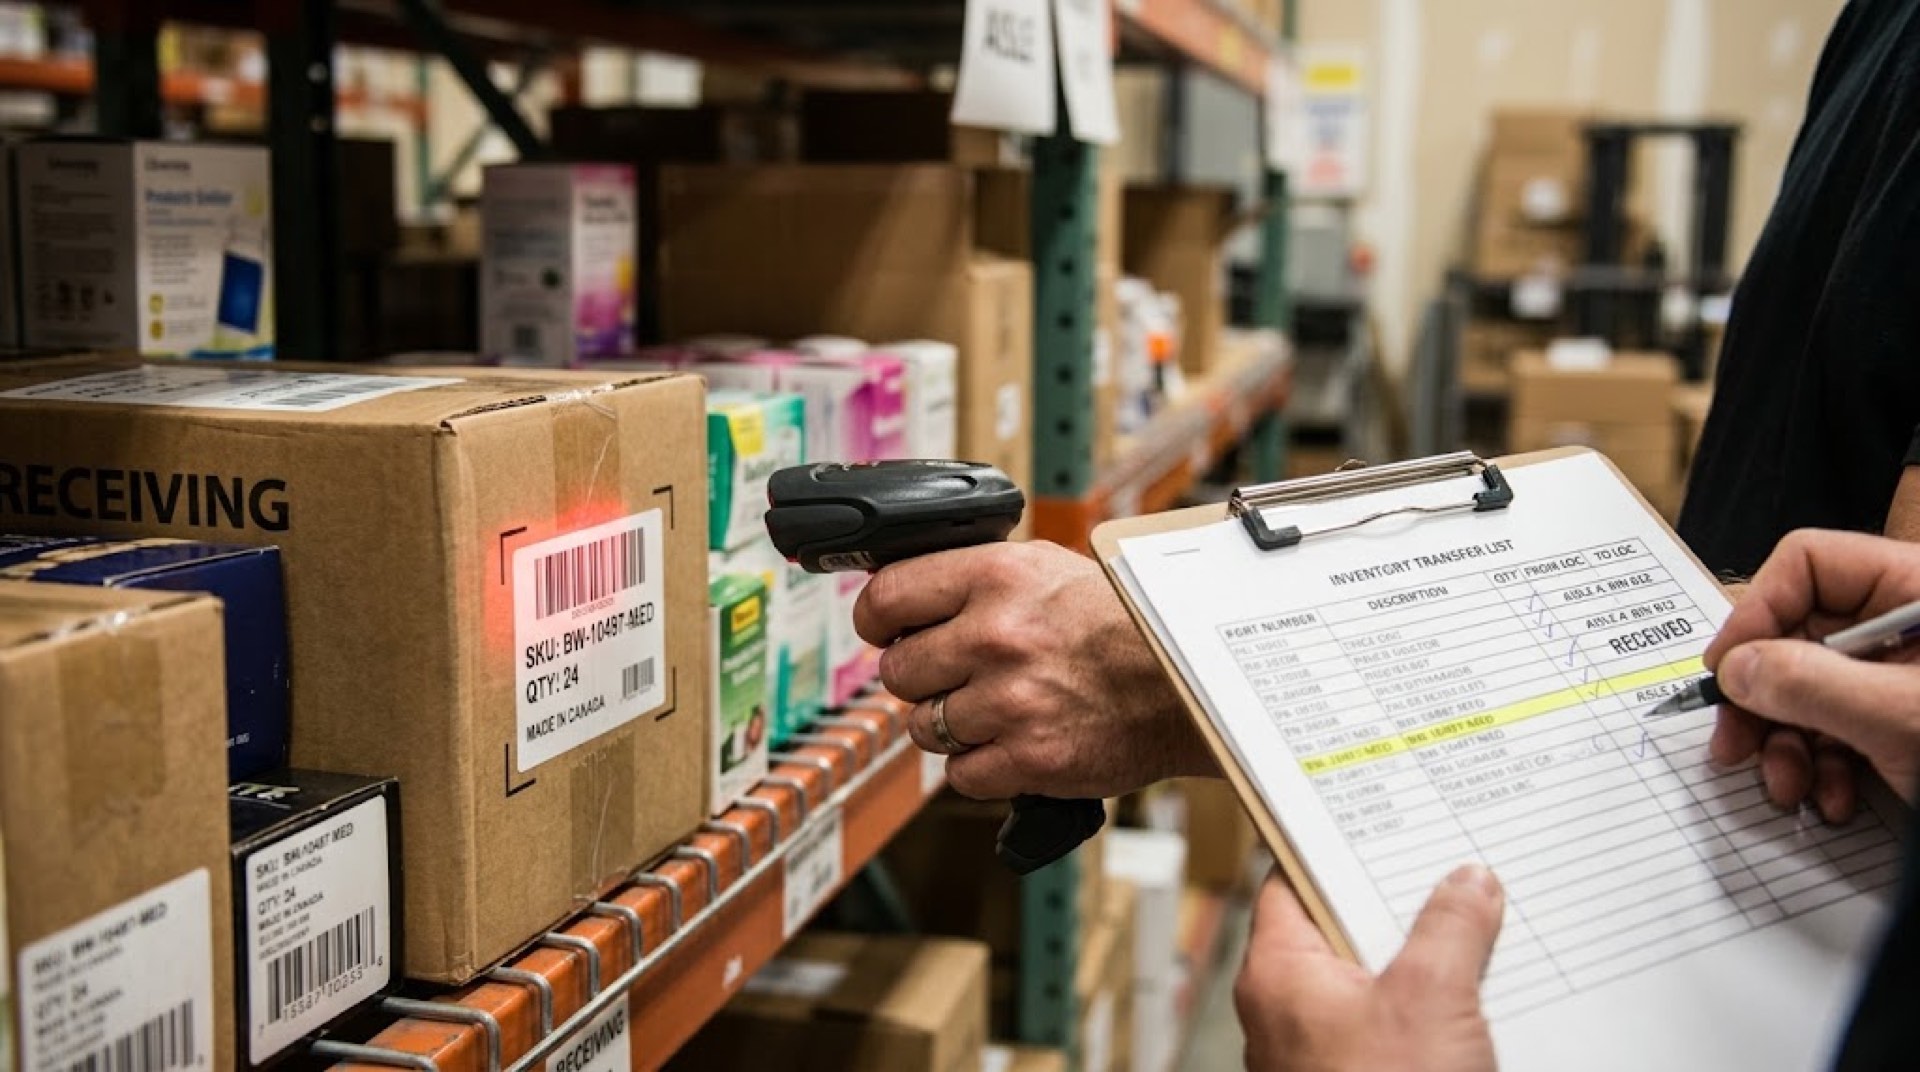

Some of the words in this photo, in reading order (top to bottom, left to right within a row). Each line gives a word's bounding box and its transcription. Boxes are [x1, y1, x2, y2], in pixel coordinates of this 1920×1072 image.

[0, 463, 290, 531] RECEIVING
[1413, 544, 1486, 569] TRANSFER
[1487, 539, 1514, 554] LIST
[526, 636, 560, 669] SKU:
[1609, 618, 1693, 654] RECEIVED
[563, 664, 579, 688] 24
